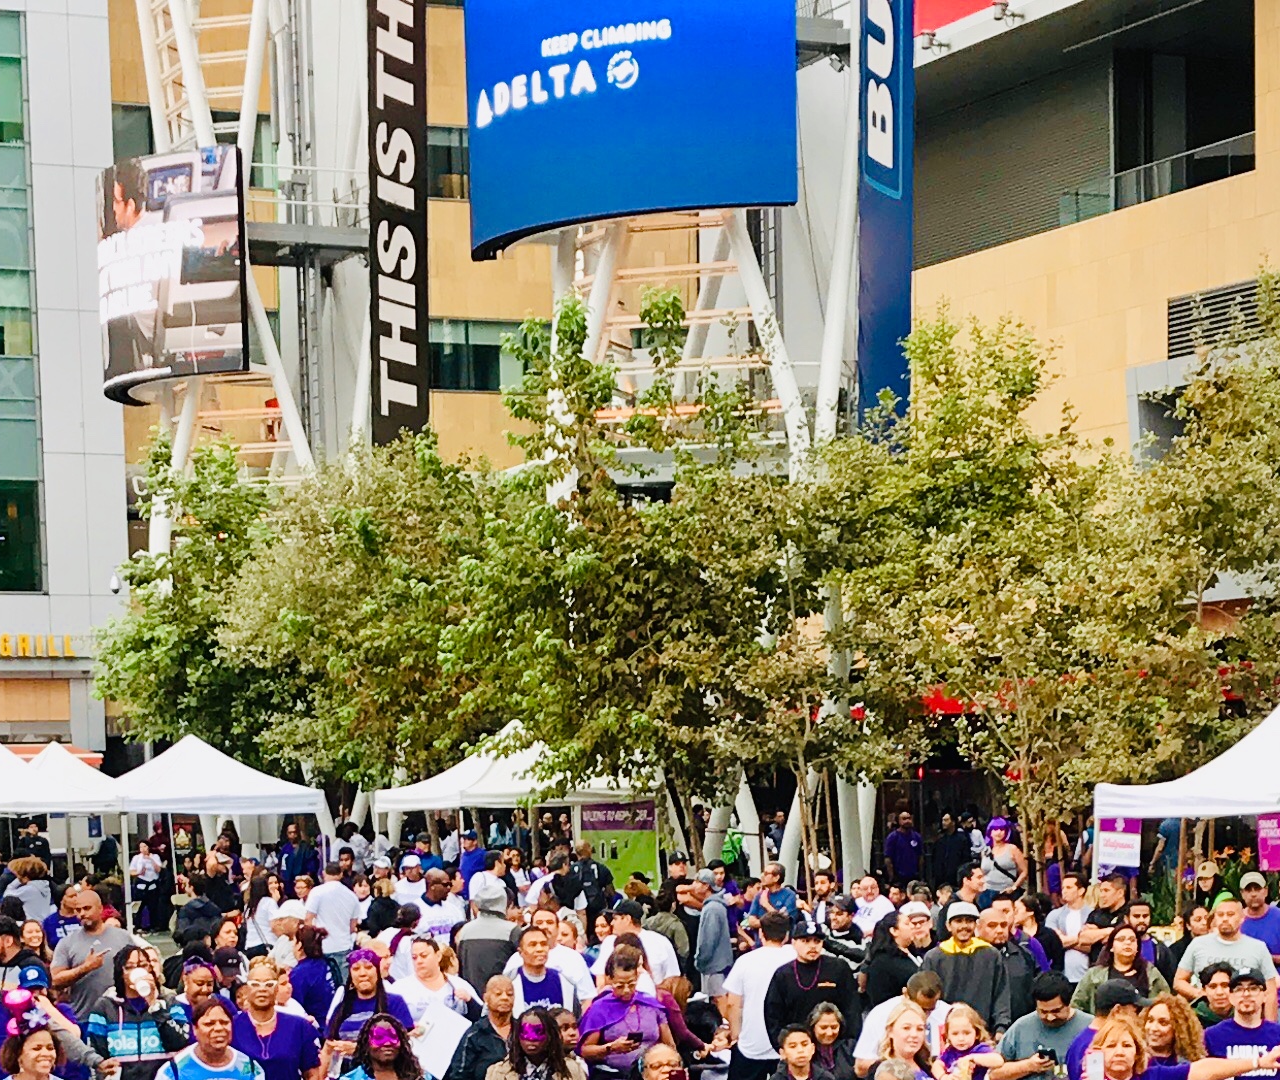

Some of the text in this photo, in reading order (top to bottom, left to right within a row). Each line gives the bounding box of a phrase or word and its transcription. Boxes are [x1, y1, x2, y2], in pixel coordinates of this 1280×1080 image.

[542, 19, 671, 58] KEEP CLIMBING
[494, 59, 597, 117] DELTA
[377, 122, 415, 211] IS
[377, 218, 417, 416] THIS
